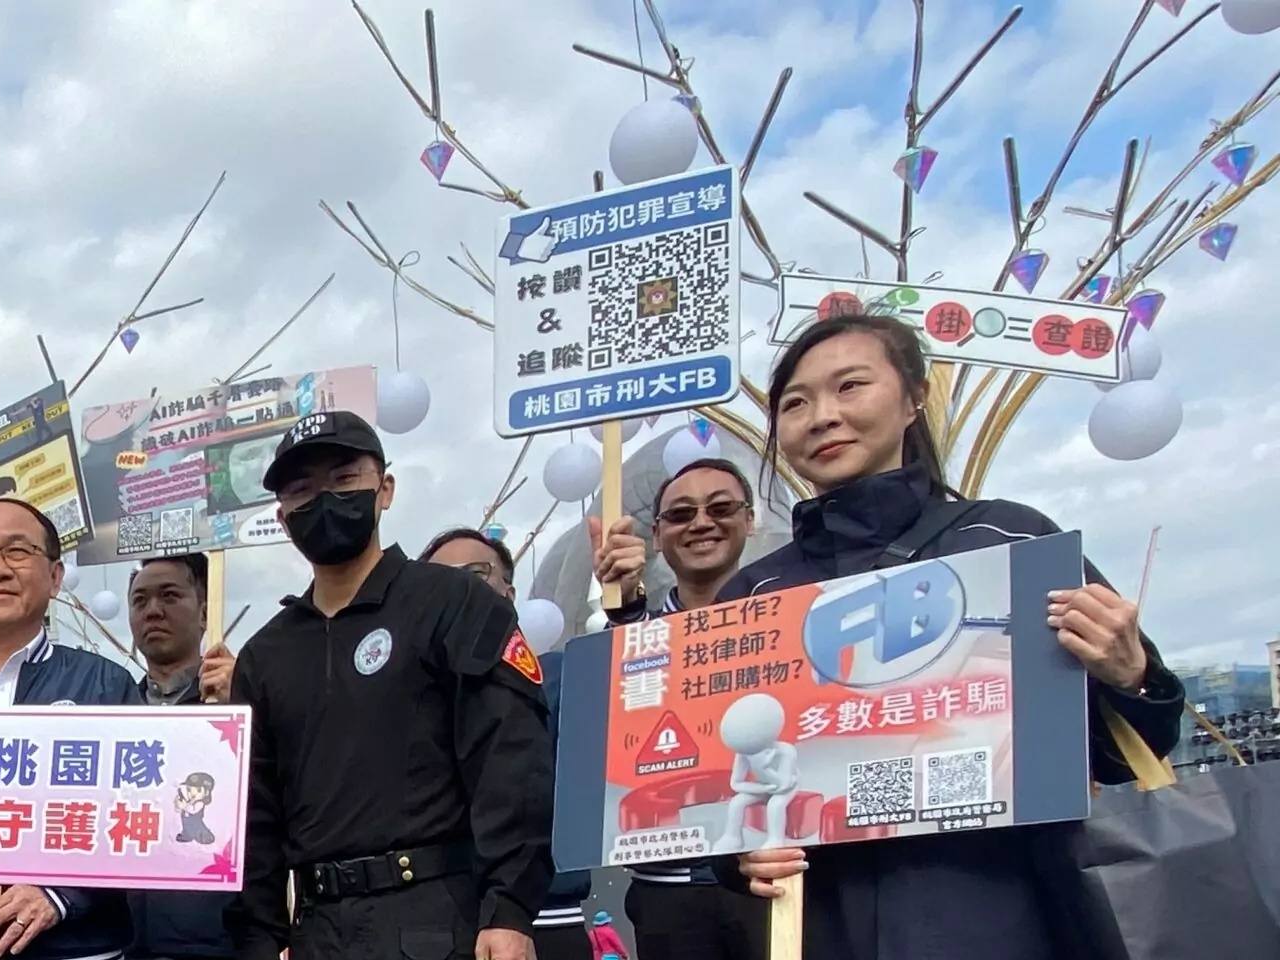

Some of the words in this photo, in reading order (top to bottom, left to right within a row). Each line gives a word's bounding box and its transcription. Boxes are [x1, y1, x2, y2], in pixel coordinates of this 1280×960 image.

[550, 184, 726, 243] 預防犯罪宣導
[517, 265, 583, 300] 按讚
[537, 308, 562, 333] &
[517, 342, 584, 377] 追蹤
[524, 367, 717, 418] 桃園市刑大FB
[118, 454, 146, 465] NEW
[684, 595, 782, 637] 找工作?
[812, 563, 957, 684] FB
[623, 655, 671, 672] facebook
[683, 629, 781, 668] 找律師?
[681, 657, 804, 701] 社團購物?
[797, 680, 1007, 741] 多數是詐騙
[638, 762, 665, 775] SCAM
[667, 757, 696, 771] ALERT
